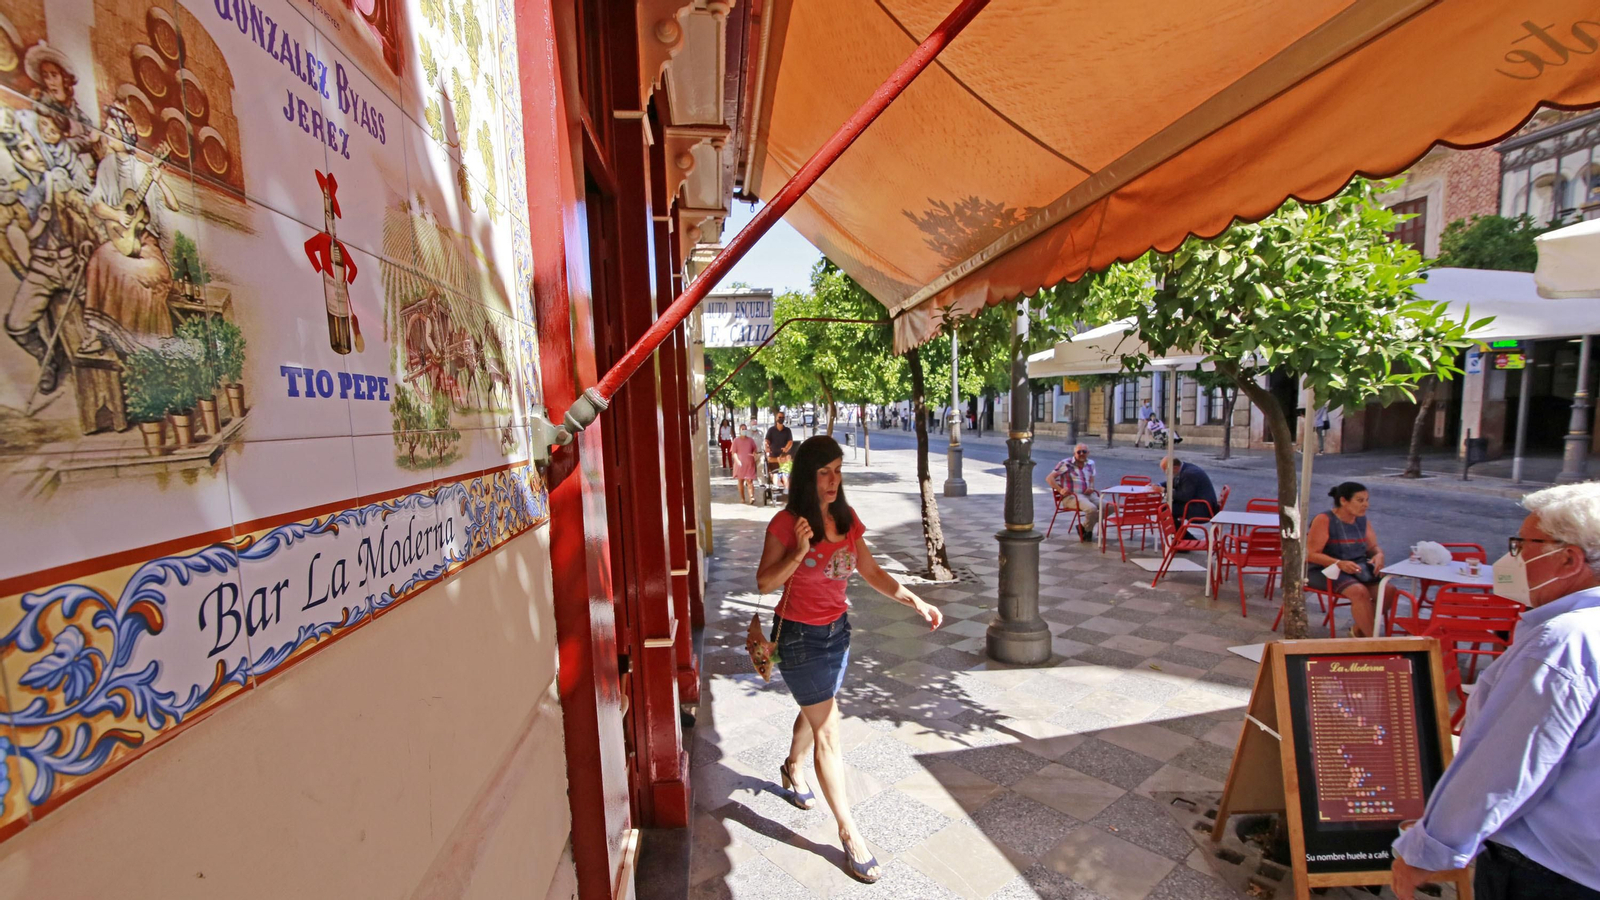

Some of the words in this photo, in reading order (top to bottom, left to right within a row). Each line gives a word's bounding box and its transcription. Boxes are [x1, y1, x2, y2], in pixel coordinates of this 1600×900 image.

[335, 60, 386, 145] BYASS
[283, 89, 350, 160] JEREZ
[707, 302, 728, 319] AUTO
[735, 301, 771, 319] ESCUELA
[710, 325, 719, 343] F.
[730, 324, 770, 342] CALIZ
[280, 365, 334, 399] TIO
[338, 372, 390, 401] PEPE
[199, 579, 289, 659] Bar
[301, 552, 350, 611] La
[357, 515, 456, 587] Moderna
[1330, 662, 1341, 672] La
[1345, 662, 1385, 672] Moderna
[1306, 853, 1315, 861] Su
[1316, 852, 1345, 860] nombre
[1346, 851, 1367, 860] huele
[1374, 850, 1389, 859] café
